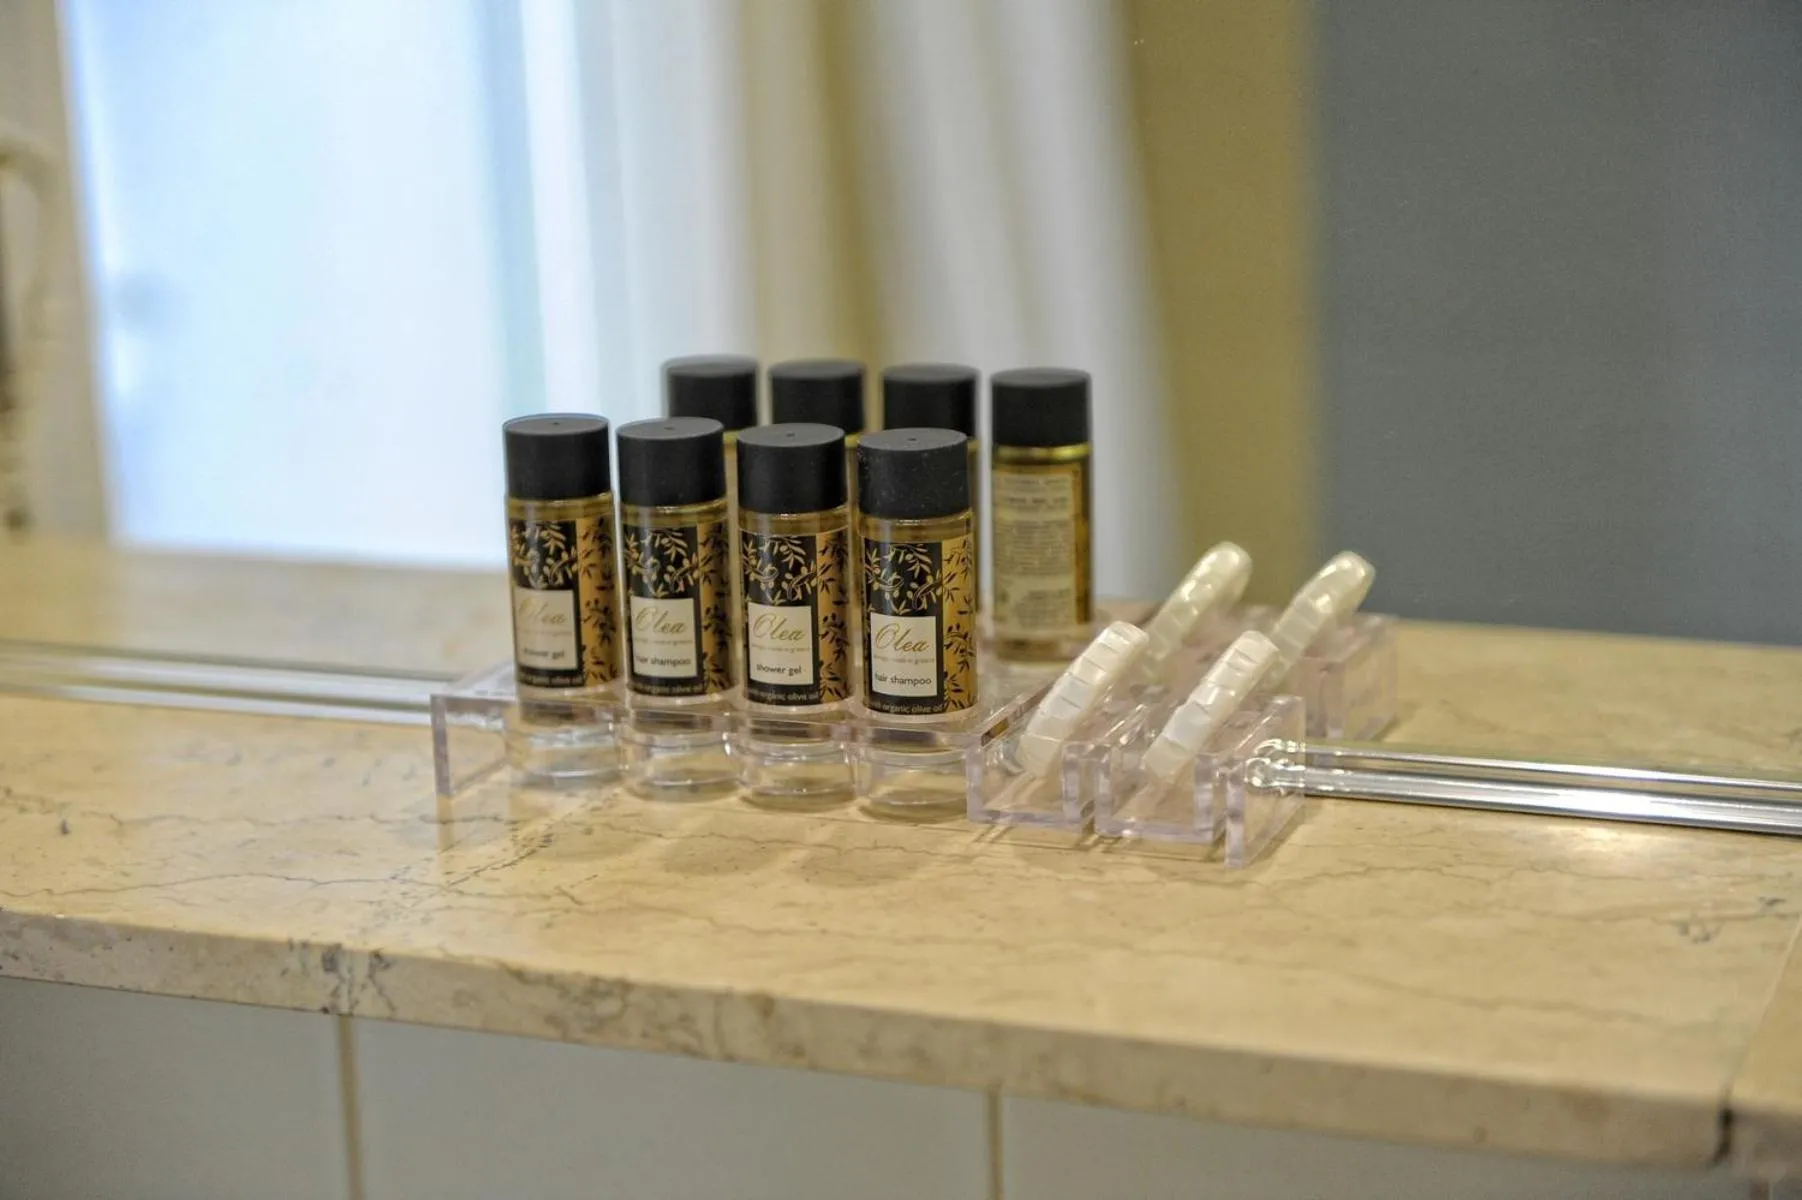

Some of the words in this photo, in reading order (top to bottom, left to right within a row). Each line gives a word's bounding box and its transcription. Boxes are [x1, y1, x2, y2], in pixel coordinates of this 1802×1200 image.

[635, 606, 686, 634] Olea
[753, 612, 806, 641] Olea
[875, 622, 930, 653] Olea
[651, 654, 692, 668] shampoo
[756, 663, 787, 674] shower
[788, 665, 802, 677] gel
[874, 672, 888, 683] hair
[890, 675, 933, 688] shampoo
